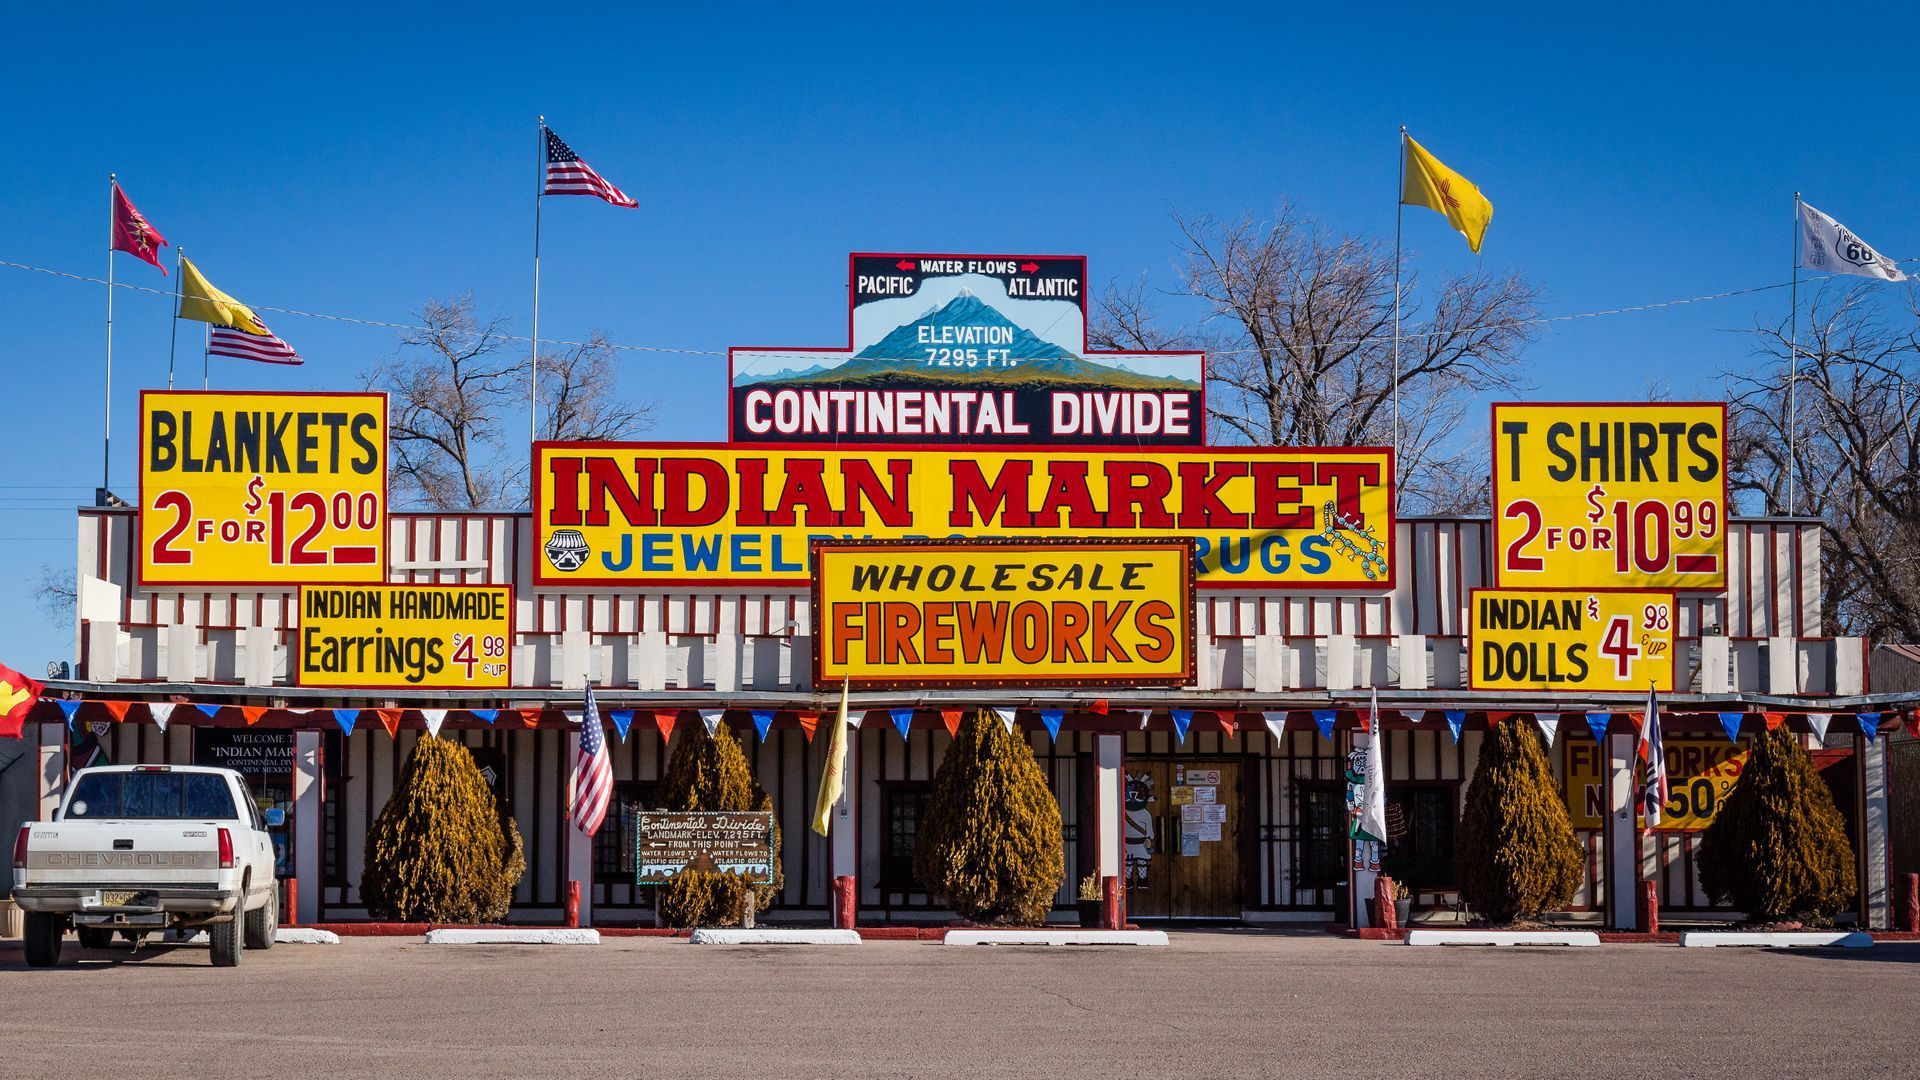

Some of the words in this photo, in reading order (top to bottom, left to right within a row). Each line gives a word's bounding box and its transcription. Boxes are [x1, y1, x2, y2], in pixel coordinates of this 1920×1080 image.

[920, 260, 963, 274] WATER
[968, 261, 1017, 274] FLOWS
[1847, 243, 1873, 261] 66
[858, 276, 914, 295] PACIFIC
[1008, 278, 1078, 297] ATLANTIC
[918, 326, 1013, 345] ELEVATION
[925, 348, 978, 366] 7295
[987, 348, 1017, 367] FT.
[745, 390, 1030, 435] CONTINENTAL
[1051, 391, 1191, 435] DIVIDE
[150, 410, 378, 475] BLANKETS
[1502, 422, 1528, 481] T
[1547, 421, 1719, 482] SHIRTS
[550, 457, 913, 527] INDIAN
[950, 460, 1381, 529] MARKET
[152, 490, 192, 565] 2
[196, 519, 267, 544] FOR
[1504, 499, 1544, 572] 2
[1547, 527, 1612, 550] FOR
[852, 563, 1154, 593] WHOLESALE
[305, 590, 382, 620] INDIAN
[390, 590, 505, 621] HANDMADE
[1480, 598, 1582, 631] INDIAN
[832, 600, 1175, 665] FIREWORKS
[304, 627, 444, 684] Earrings
[1483, 641, 1588, 683] DOLLS
[232, 735, 284, 744] WELCOME
[641, 816, 707, 832] Continental
[712, 816, 765, 831] Divide
[692, 840, 711, 848] THIS
[714, 840, 740, 848] POINT
[46, 852, 200, 867] CHEVROLET
